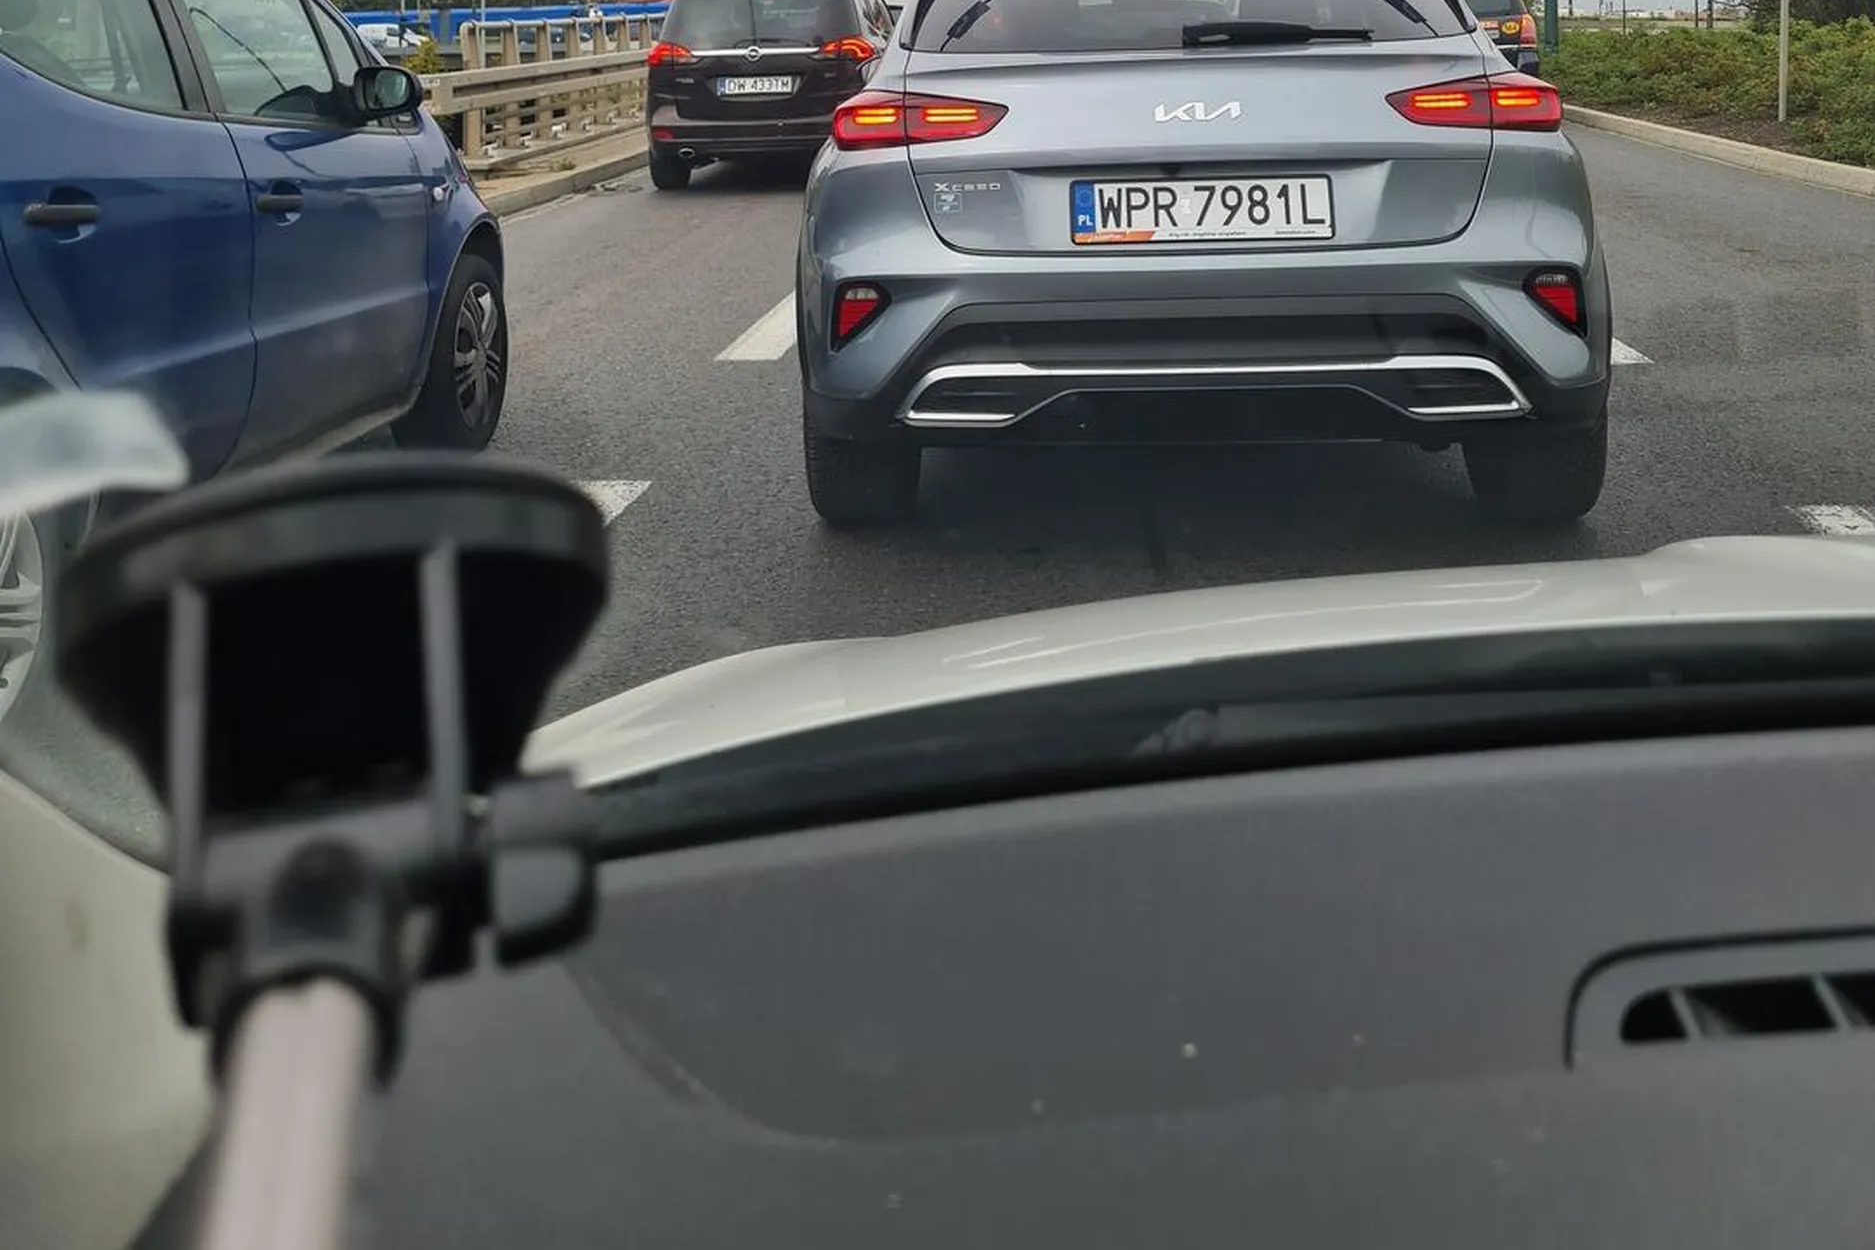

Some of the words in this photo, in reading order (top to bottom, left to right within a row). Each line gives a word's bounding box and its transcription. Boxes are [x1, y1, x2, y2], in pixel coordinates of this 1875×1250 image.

[1078, 214, 1094, 227] PL
[1098, 185, 1178, 229] WPR
[1193, 182, 1326, 227] 7981L
